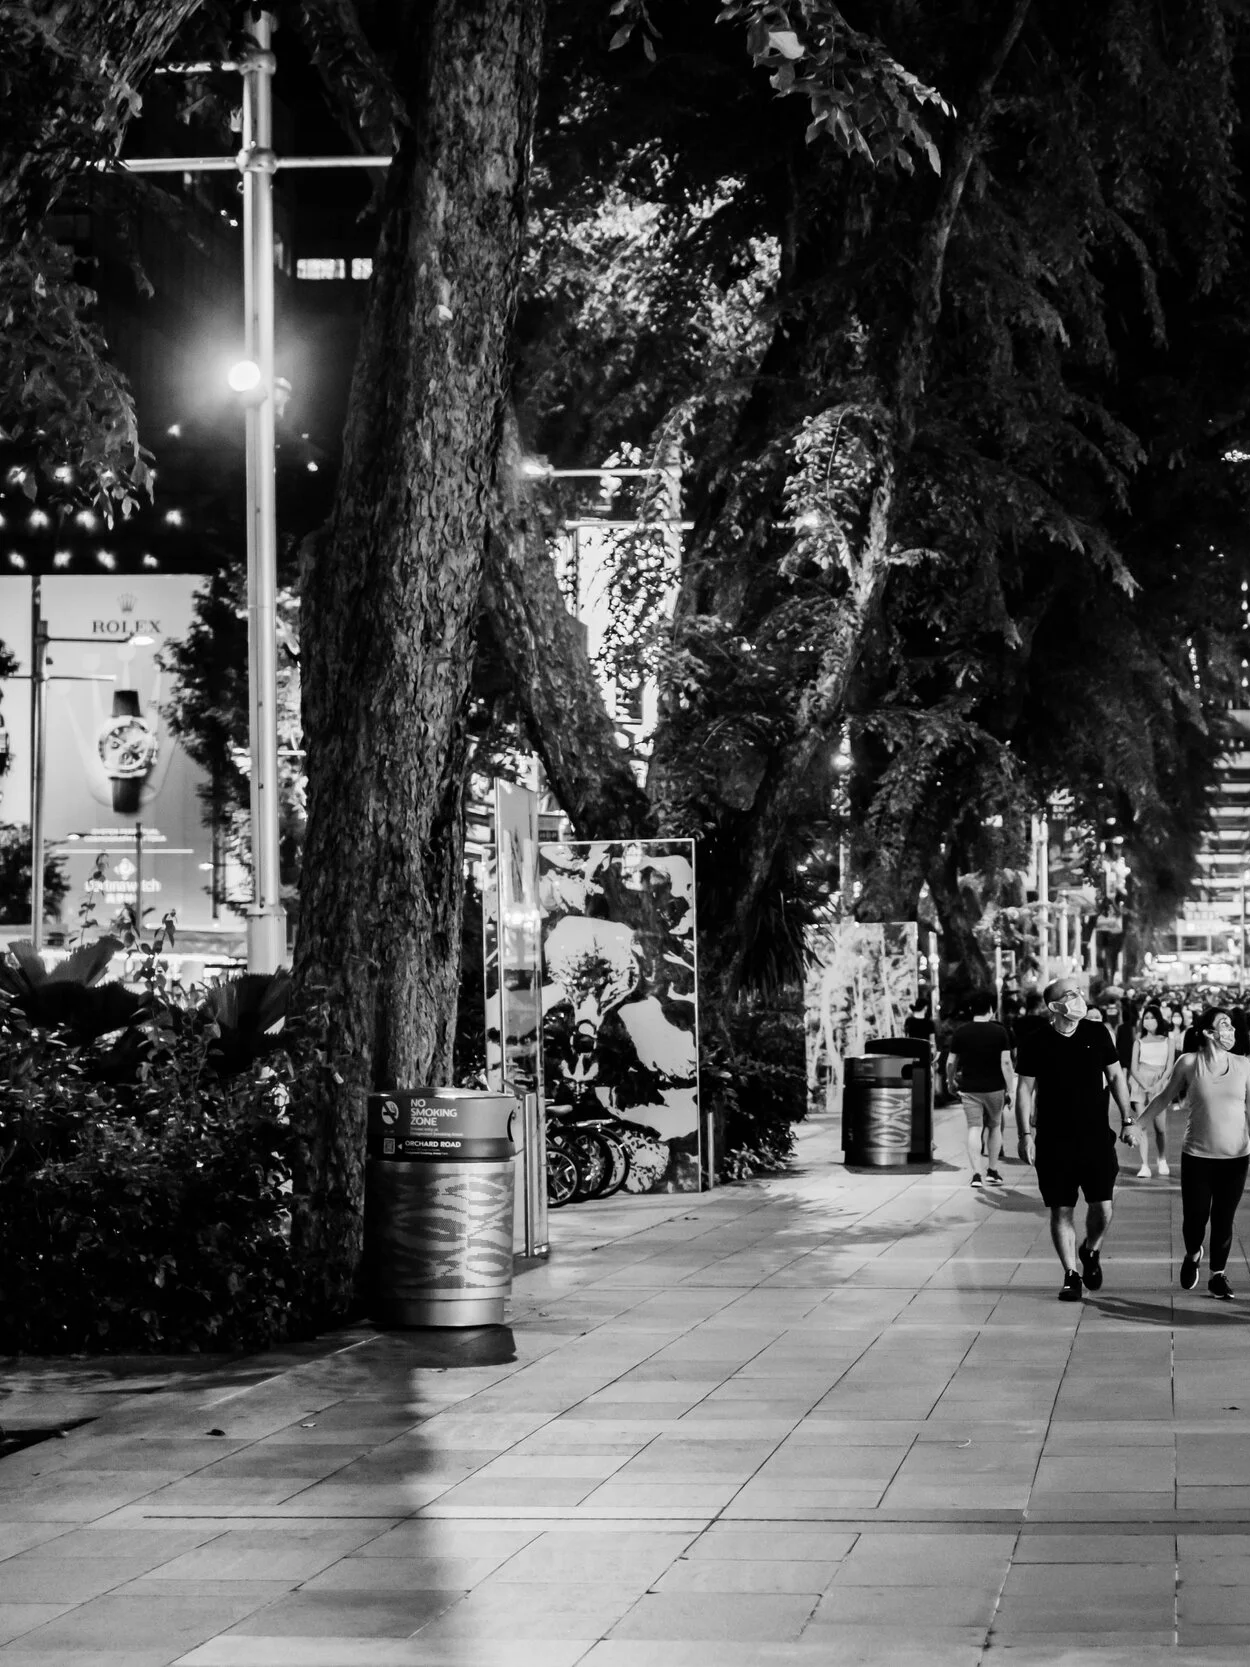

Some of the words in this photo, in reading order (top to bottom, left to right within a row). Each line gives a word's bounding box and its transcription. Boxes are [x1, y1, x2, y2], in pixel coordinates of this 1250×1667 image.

[93, 620, 161, 633] ROLEX
[411, 1099, 426, 1108] NO
[411, 1108, 458, 1118] SMOKING
[411, 1117, 438, 1126] ZONE
